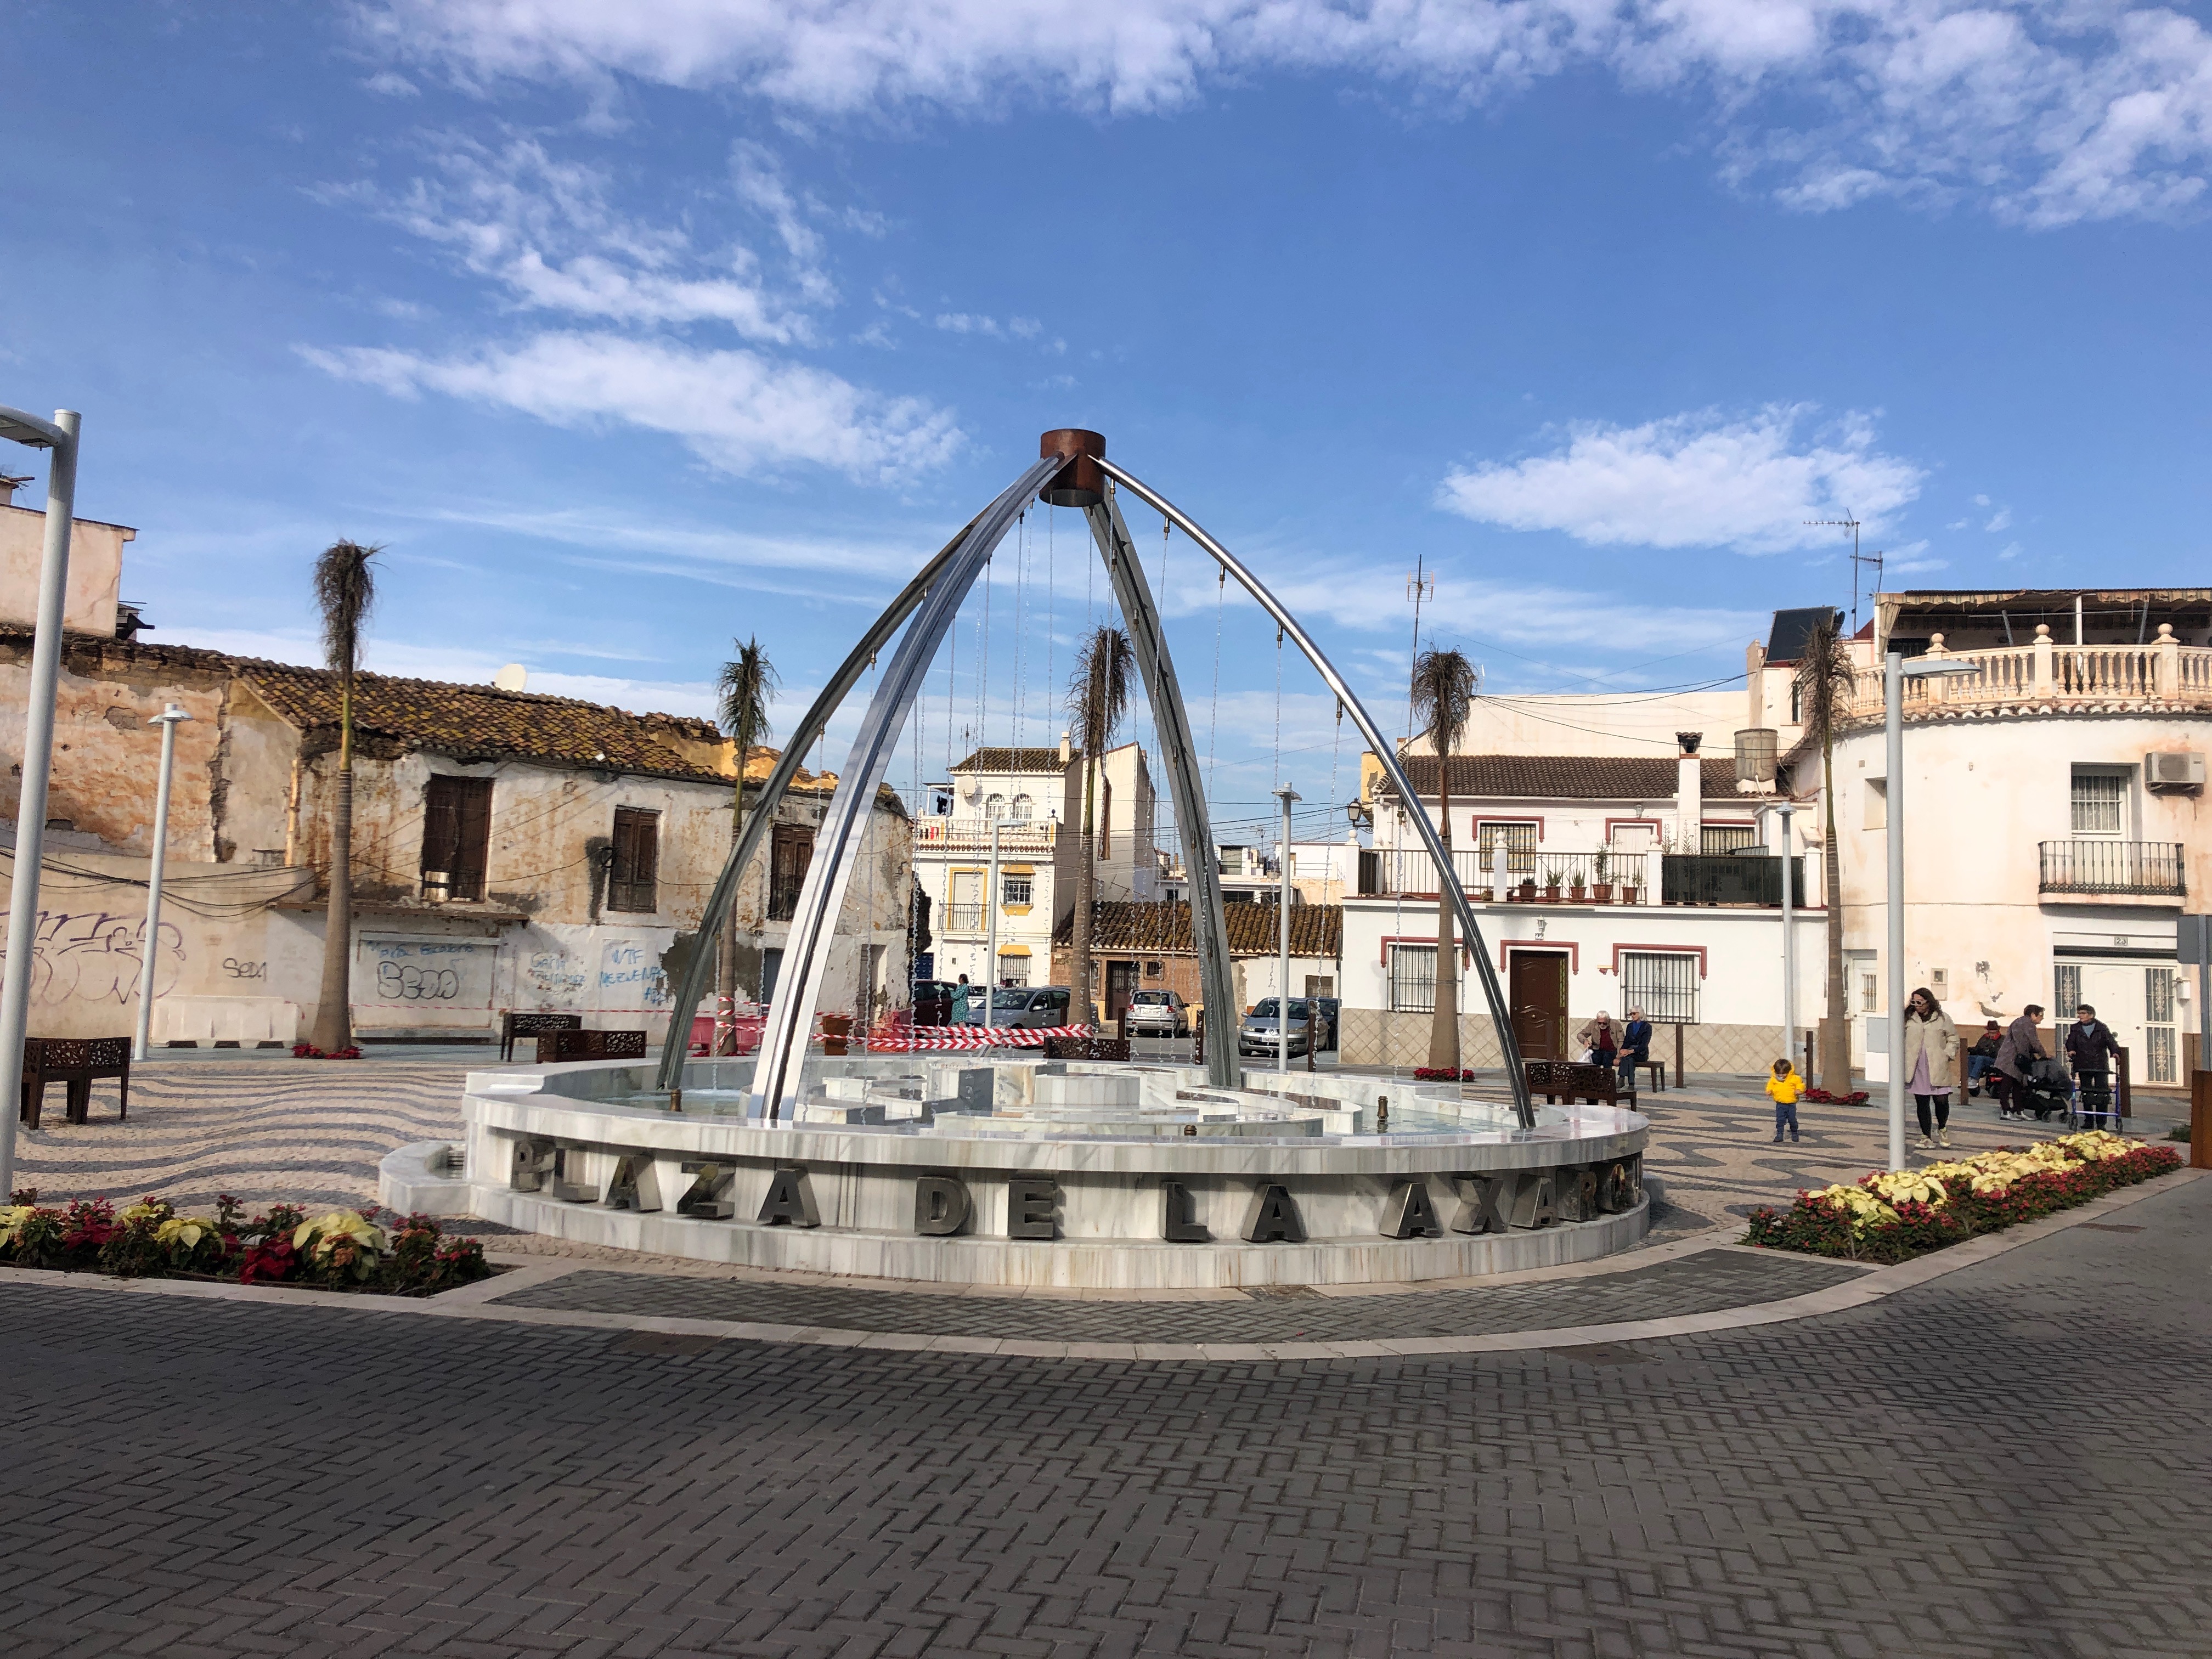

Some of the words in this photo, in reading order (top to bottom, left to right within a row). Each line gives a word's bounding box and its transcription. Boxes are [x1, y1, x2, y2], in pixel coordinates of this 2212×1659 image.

[510, 1139, 821, 1227] PLAZA
[914, 1175, 1054, 1239] DE
[1160, 1180, 1304, 1242] LA
